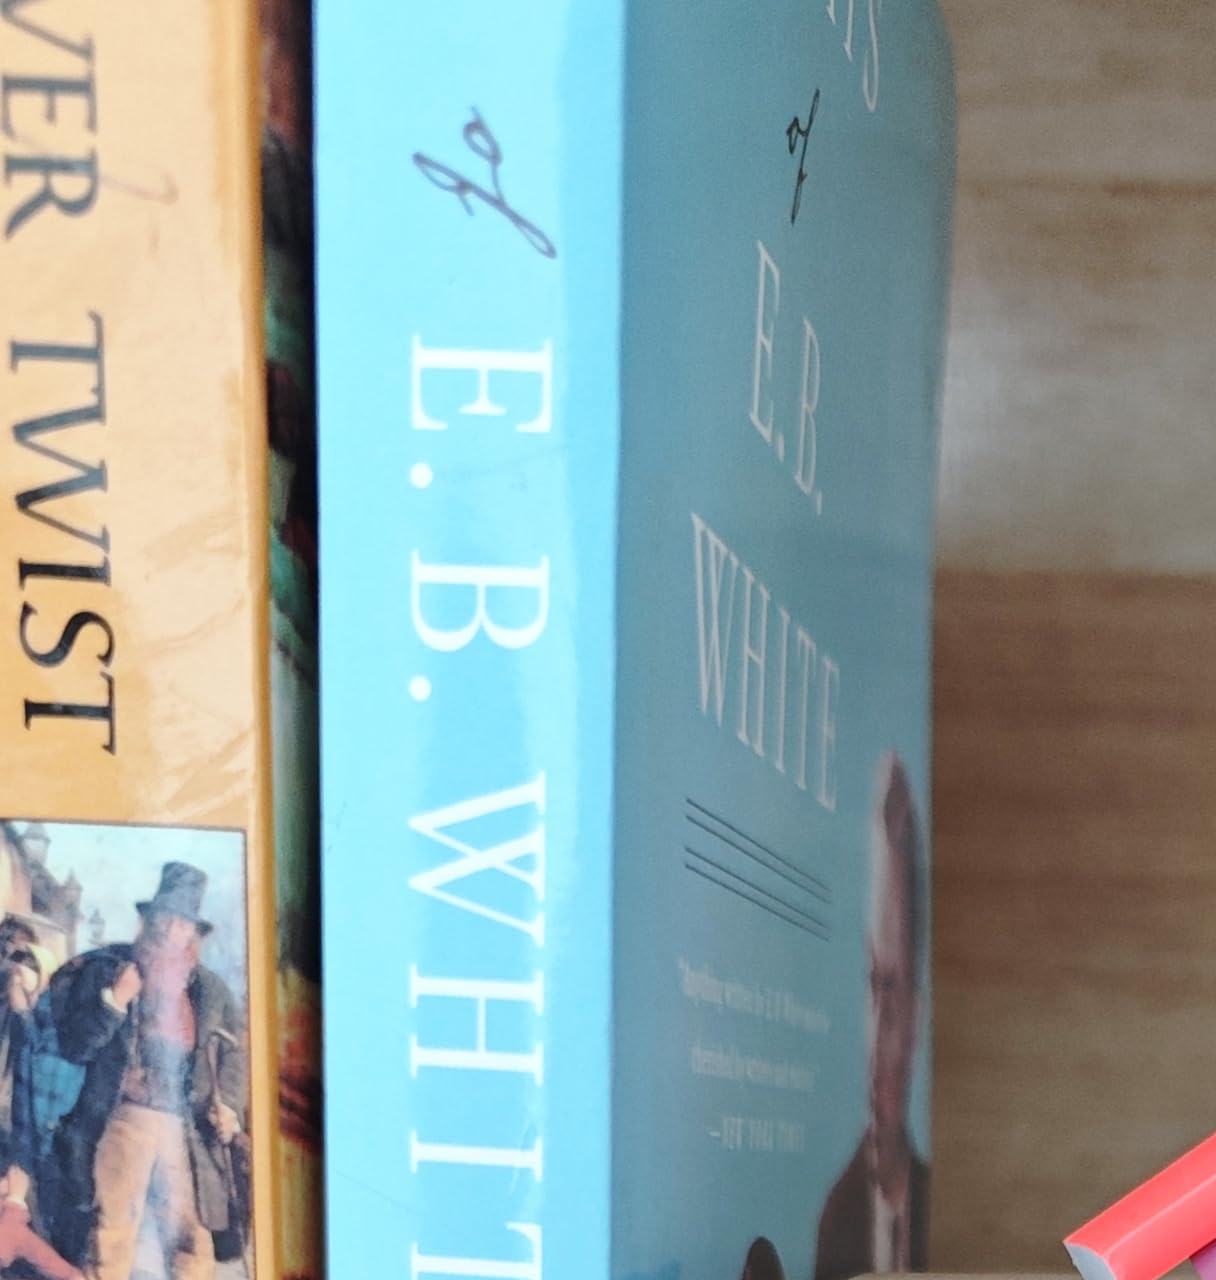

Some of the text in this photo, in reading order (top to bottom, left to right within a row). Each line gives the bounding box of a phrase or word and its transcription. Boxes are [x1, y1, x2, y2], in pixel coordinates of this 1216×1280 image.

[411, 104, 558, 259] of
[785, 87, 821, 226] of
[9, 308, 117, 756] TWIST
[690, 510, 841, 813] WHITE
